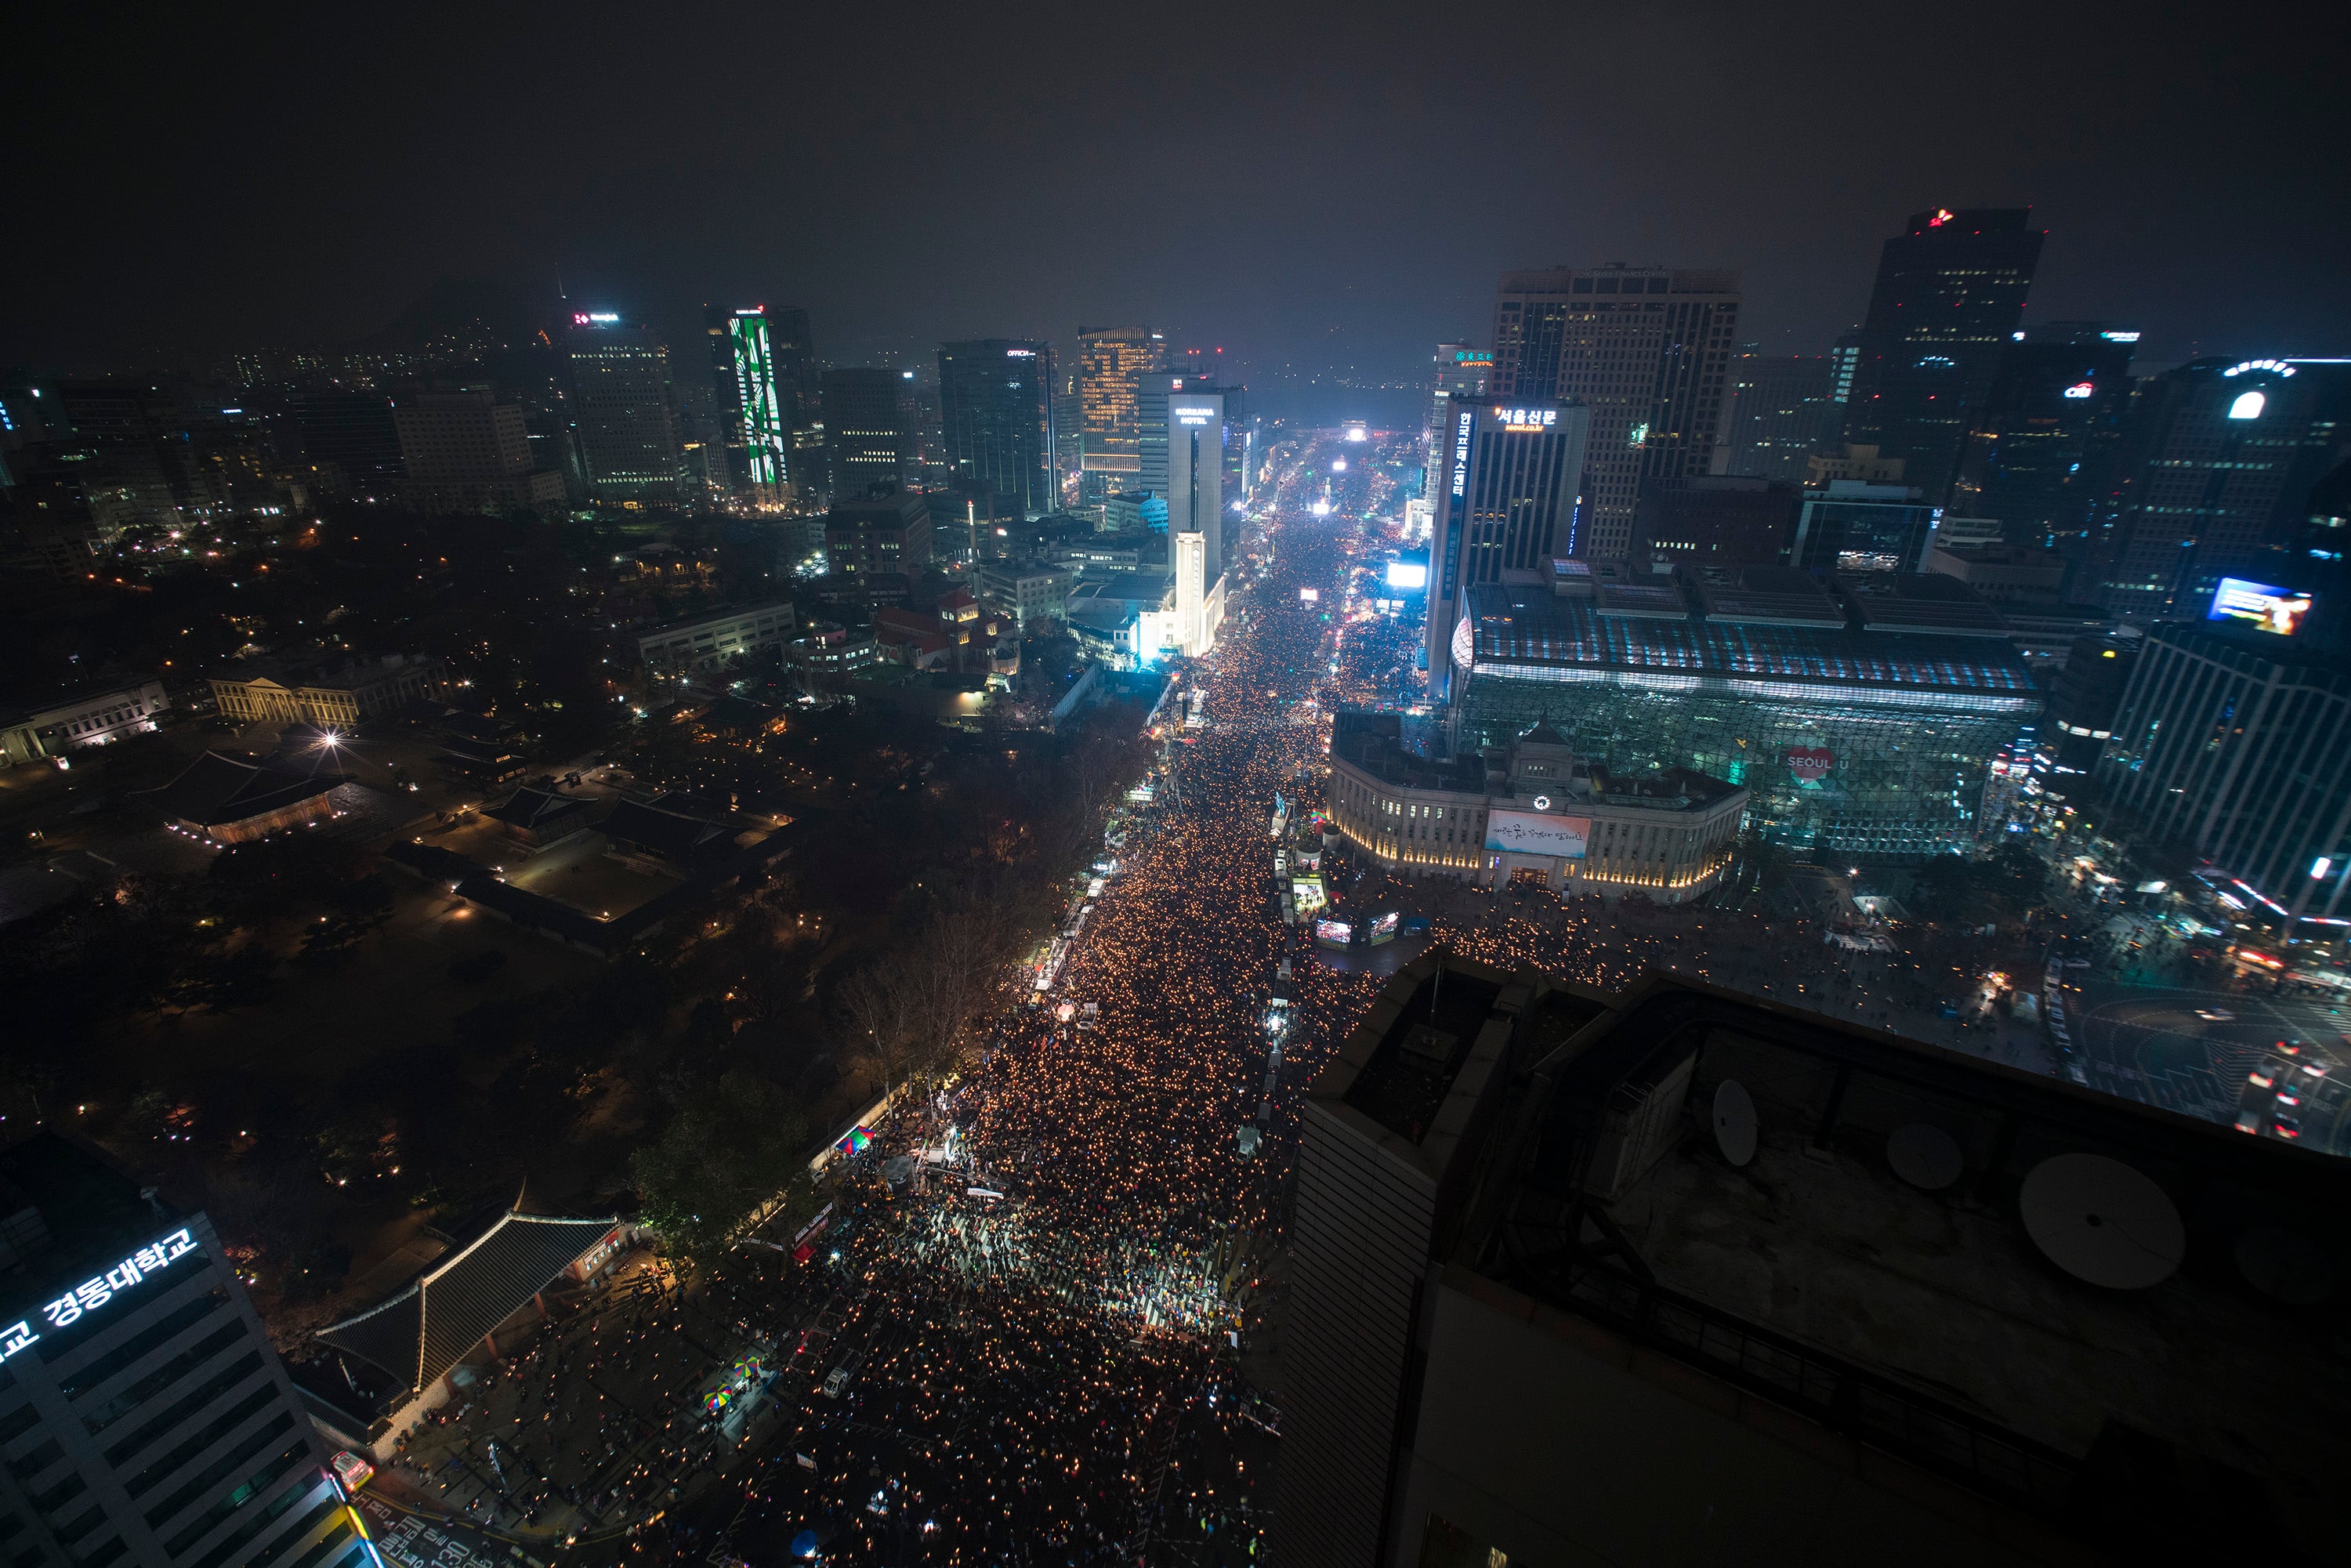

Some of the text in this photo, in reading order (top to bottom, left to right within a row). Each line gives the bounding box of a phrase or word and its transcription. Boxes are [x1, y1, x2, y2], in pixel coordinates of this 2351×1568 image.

[1498, 409, 1556, 425] 서울신문
[1452, 412, 1472, 497] 한국프레스센터
[1788, 756, 1832, 769] SEOUL
[1839, 759, 1849, 770] U
[0, 1227, 198, 1364] 교 경동대학교
